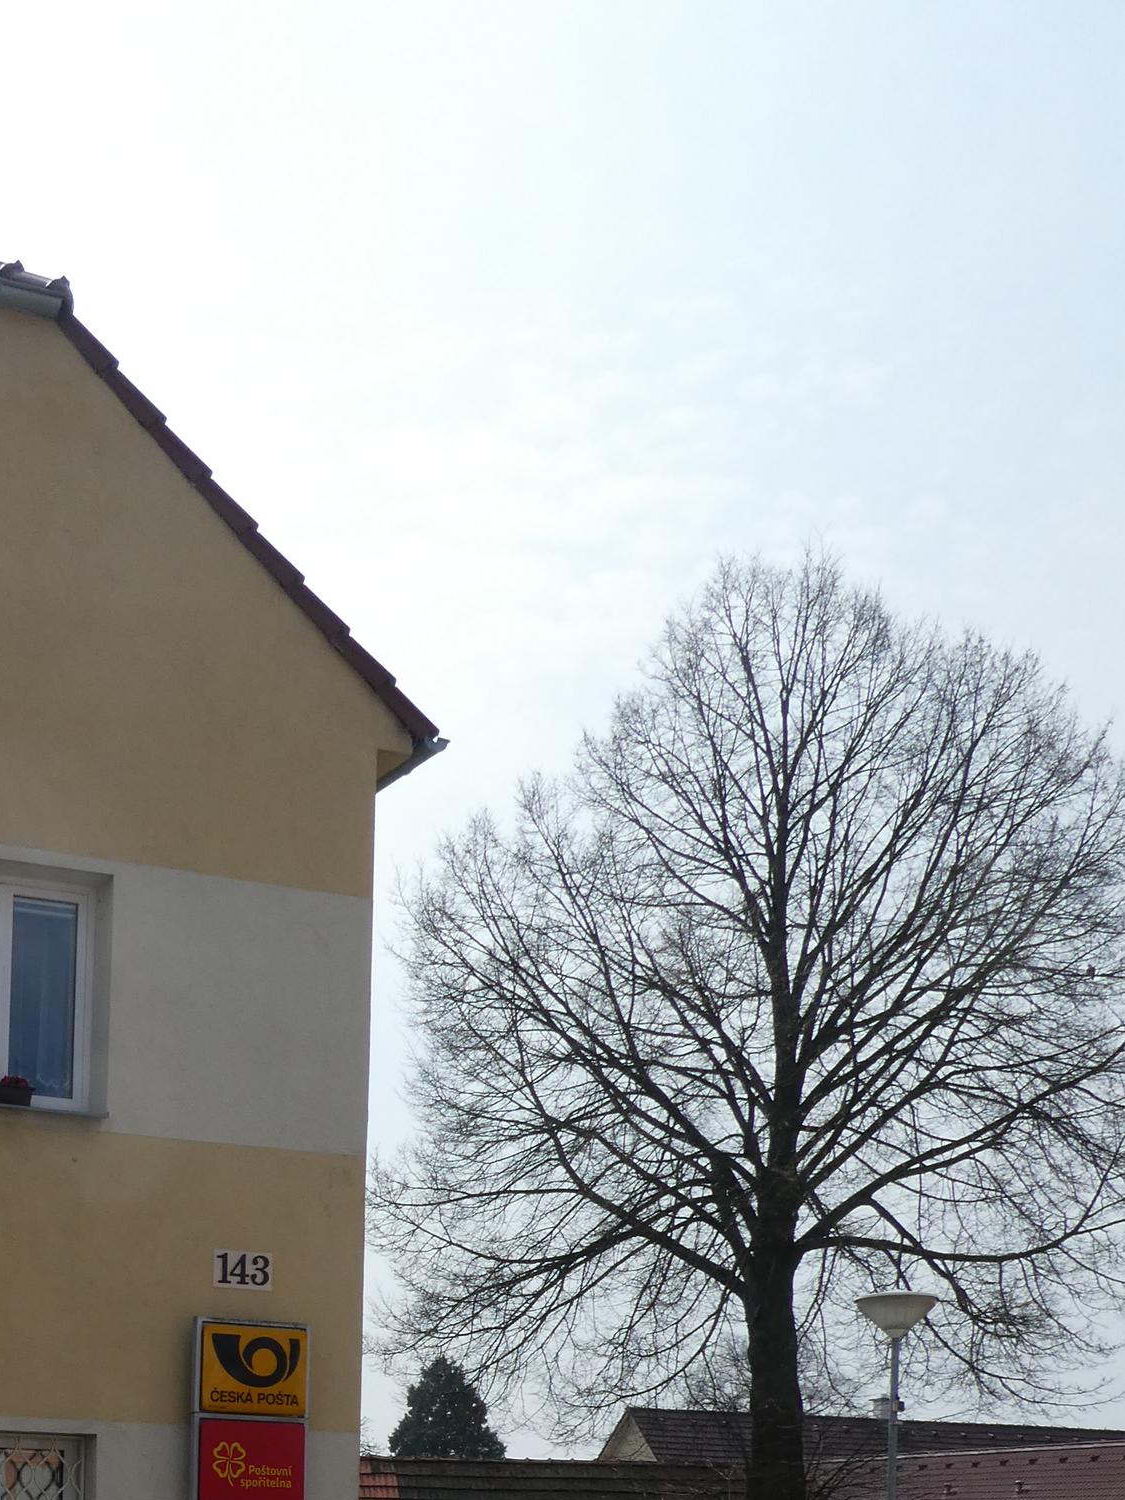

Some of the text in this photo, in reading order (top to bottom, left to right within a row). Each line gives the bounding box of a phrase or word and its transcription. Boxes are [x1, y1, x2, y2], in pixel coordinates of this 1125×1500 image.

[216, 1252, 270, 1286] 143
[210, 1387, 299, 1406] ČESKÁ POŠTA
[249, 1465, 292, 1476] Poštovní
[240, 1477, 292, 1489] spořitelna
